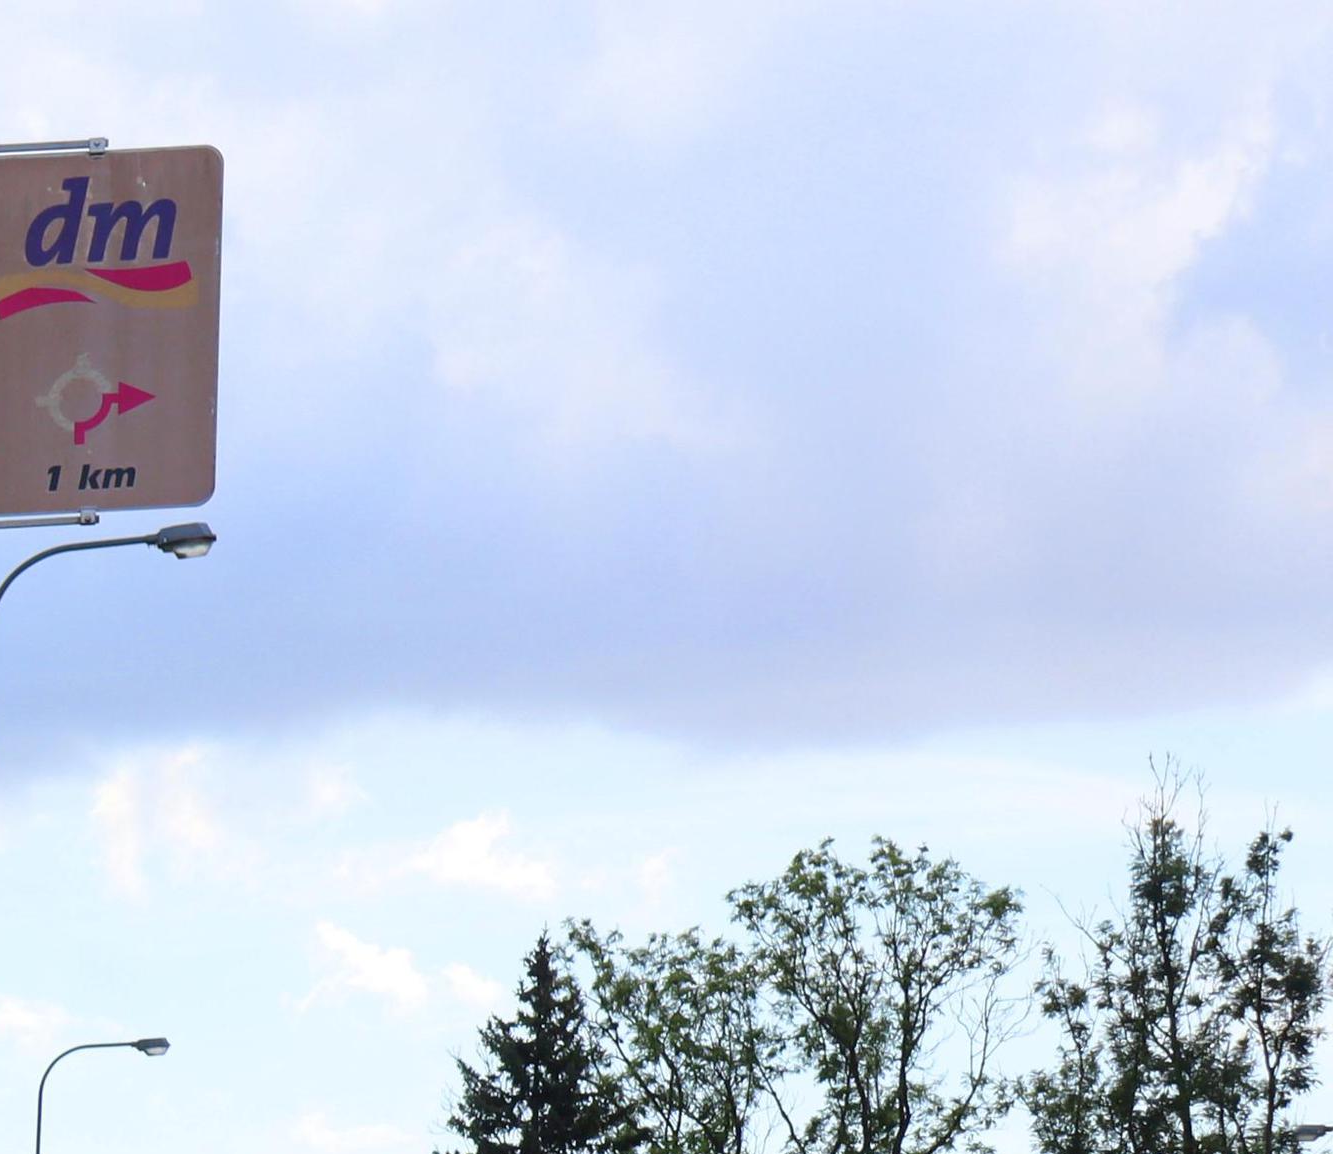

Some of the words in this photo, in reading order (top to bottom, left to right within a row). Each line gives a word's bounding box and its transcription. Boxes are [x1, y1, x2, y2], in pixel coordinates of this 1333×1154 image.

[24, 176, 177, 267] dm
[47, 465, 61, 491] 1
[78, 464, 136, 491] km
